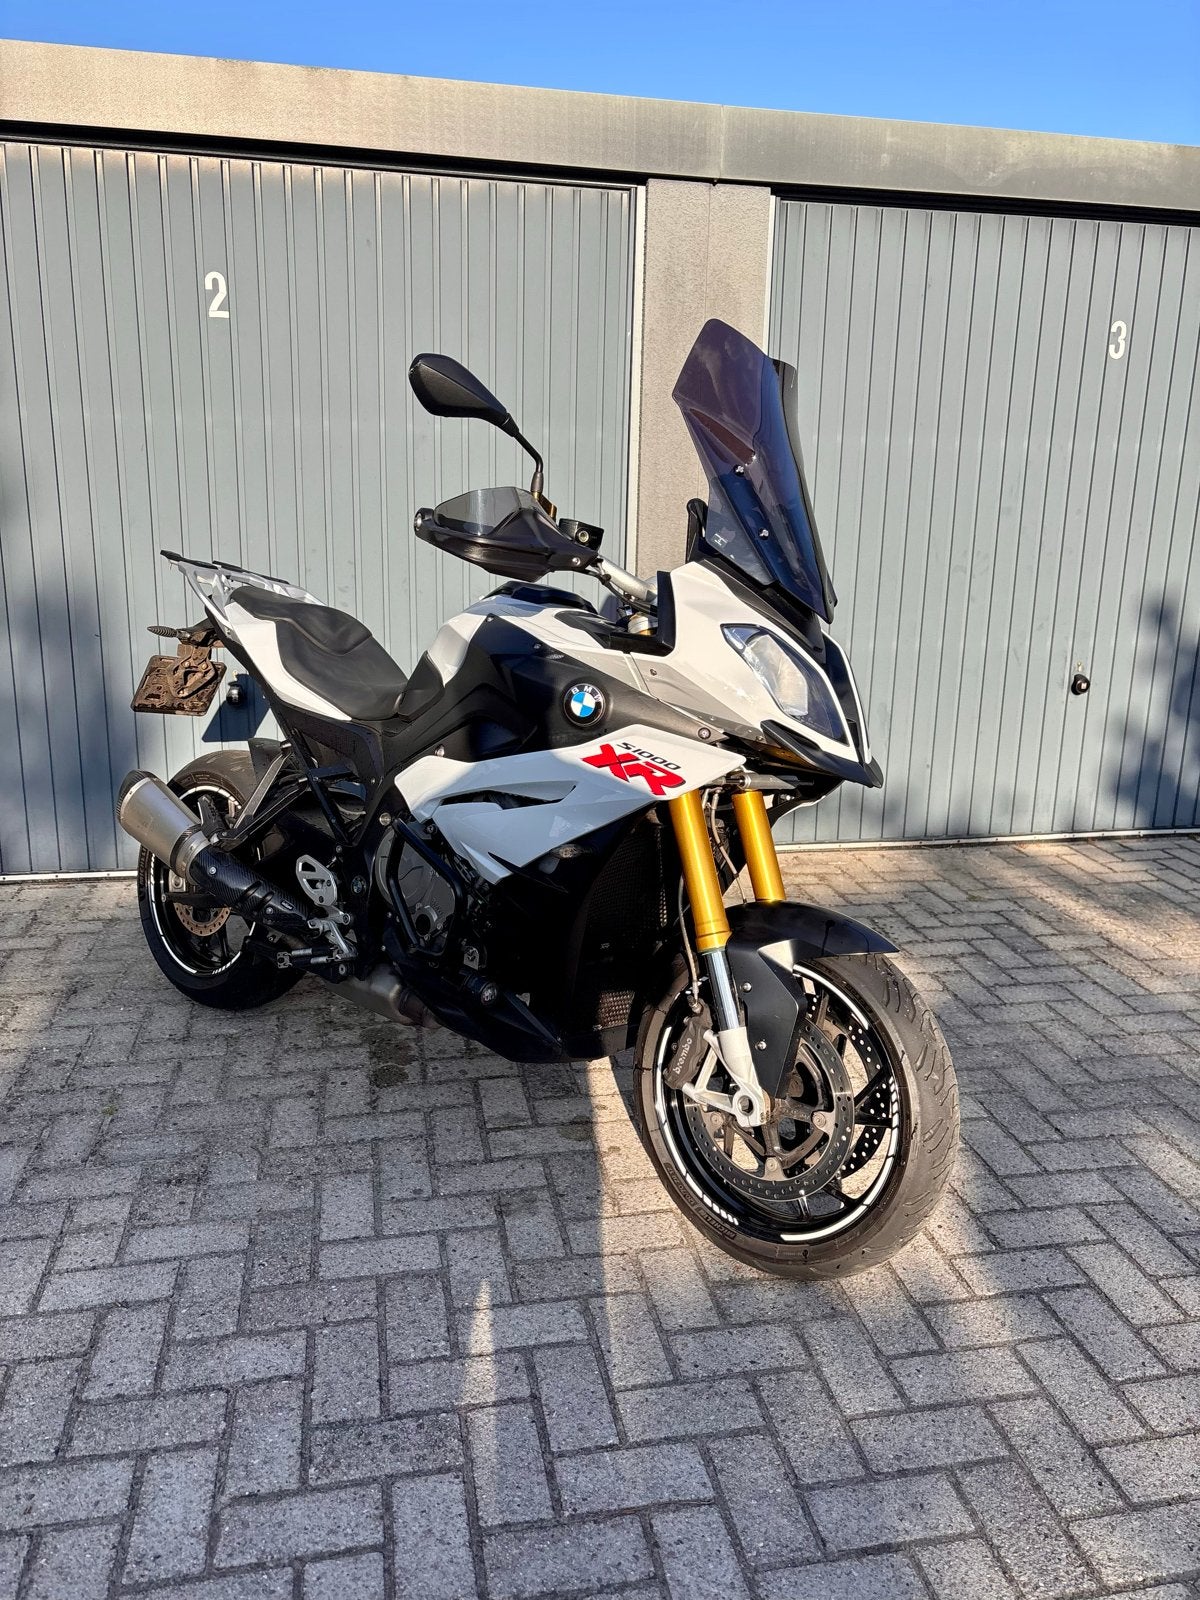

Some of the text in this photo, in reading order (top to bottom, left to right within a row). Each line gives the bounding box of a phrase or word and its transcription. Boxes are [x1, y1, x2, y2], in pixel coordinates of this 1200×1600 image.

[205, 271, 229, 319] 2
[1109, 320, 1127, 360] 3
[571, 685, 603, 703] BMW
[581, 743, 686, 796] XR
[672, 1037, 693, 1075] brembo
